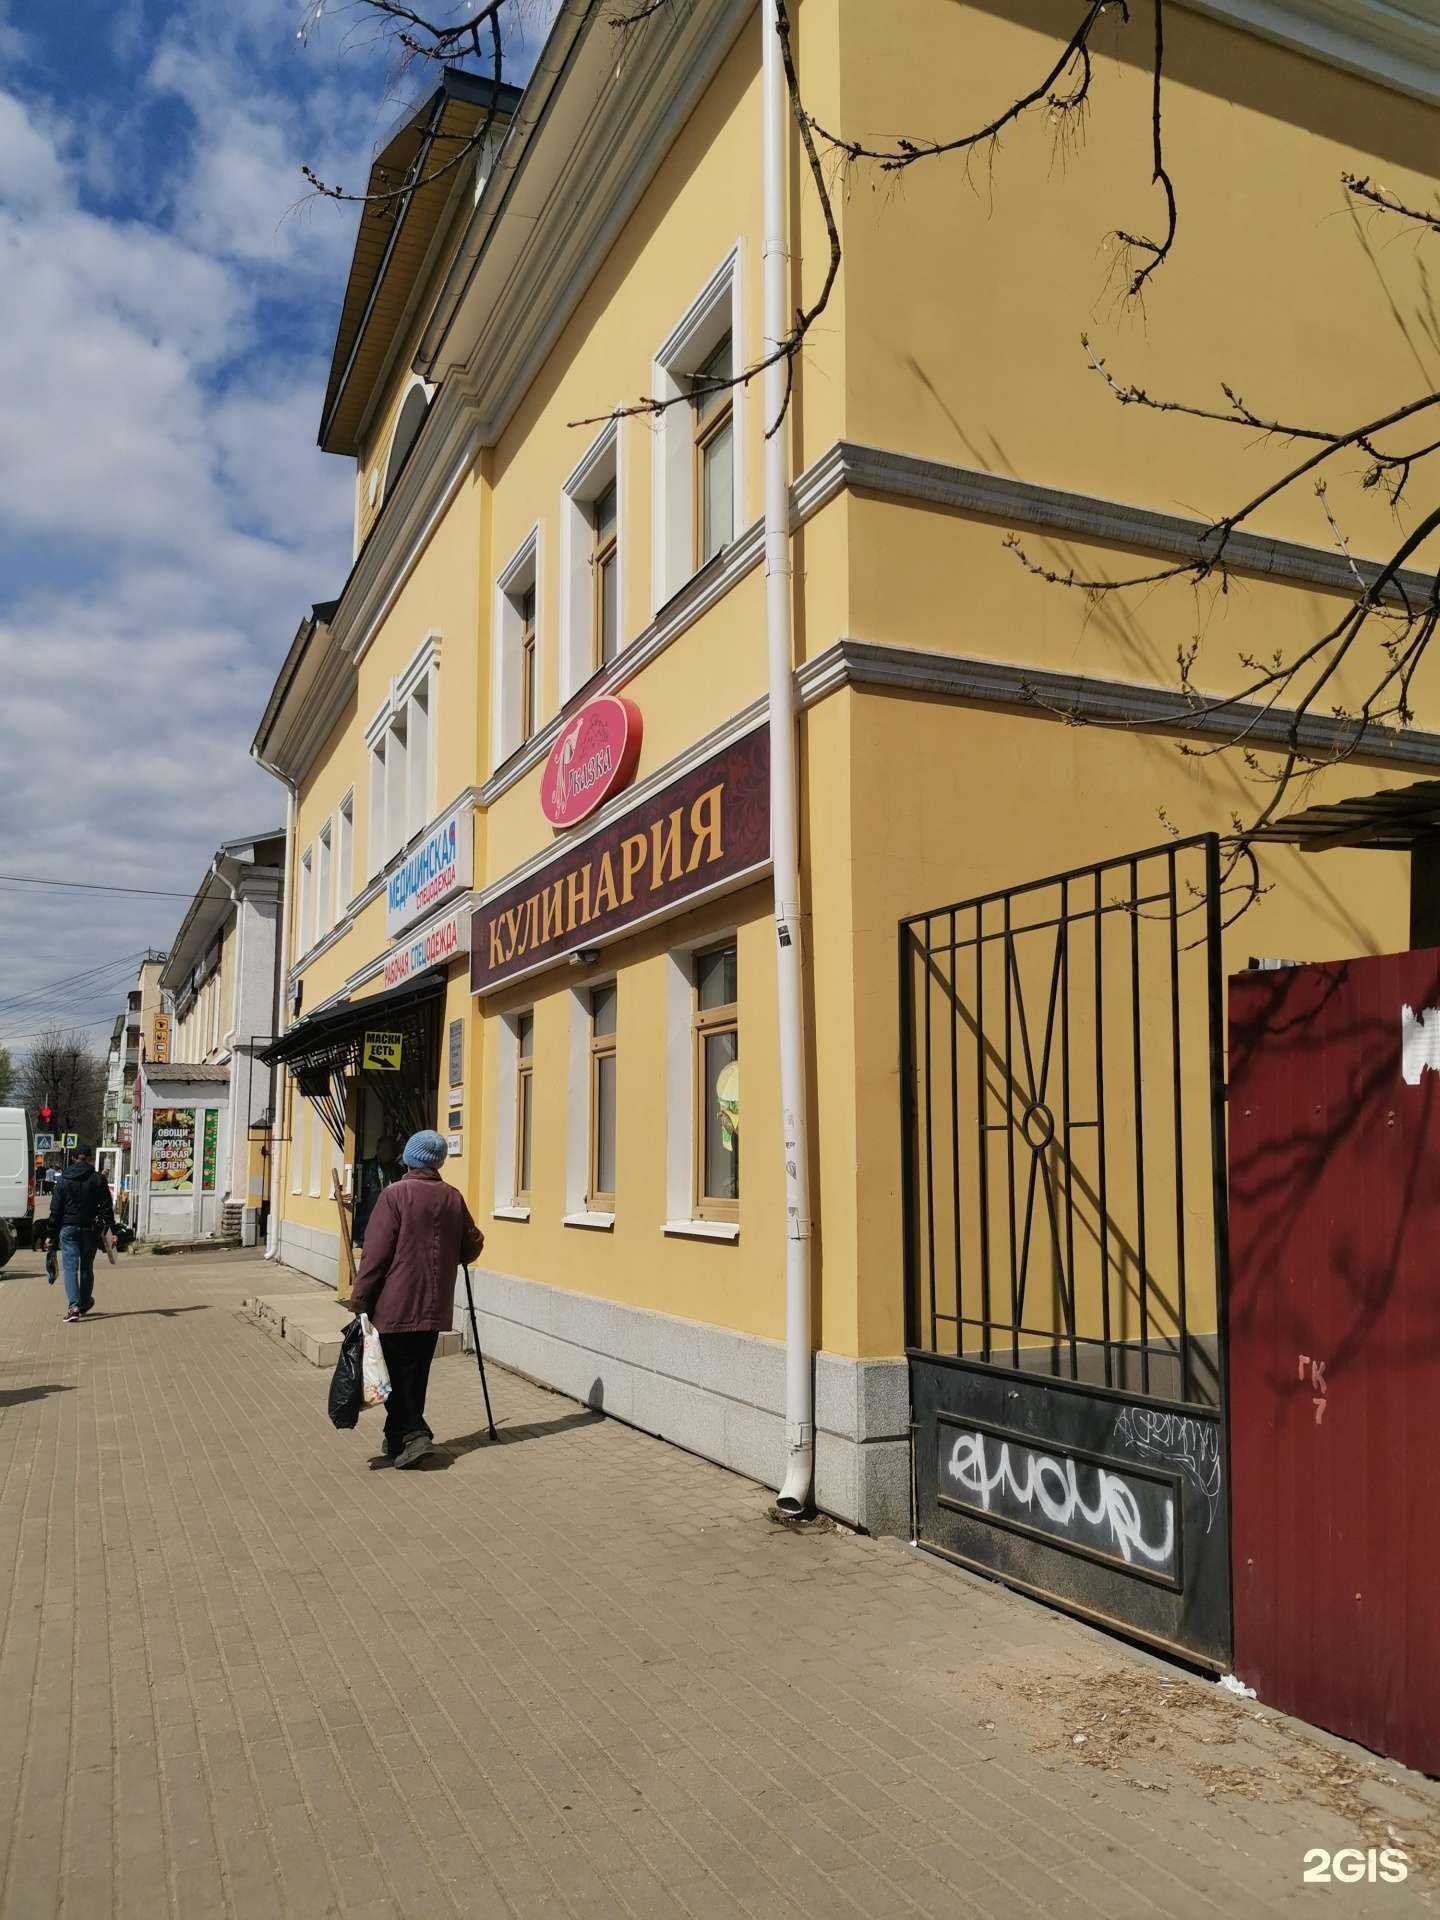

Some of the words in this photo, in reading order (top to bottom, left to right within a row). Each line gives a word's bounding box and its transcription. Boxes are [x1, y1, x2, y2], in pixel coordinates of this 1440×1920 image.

[389, 821, 456, 913] МЕДИЦИНСКАЯ
[488, 783, 724, 969] КУЛИНАРИЯ
[416, 864, 456, 910] СПЕЦОДЕЖДА
[411, 920, 457, 970] СПЕЦОДЕЖДА
[366, 1033, 401, 1044] МАСКИ
[371, 1045, 395, 1056] ЕСТЬ
[157, 1128, 189, 1138] ОВОЩИ
[154, 1140, 191, 1149] ФРУКТЫ
[155, 1150, 190, 1159] СВЕЖАЯ
[156, 1161, 188, 1170] ЗЕЛЕНЬ
